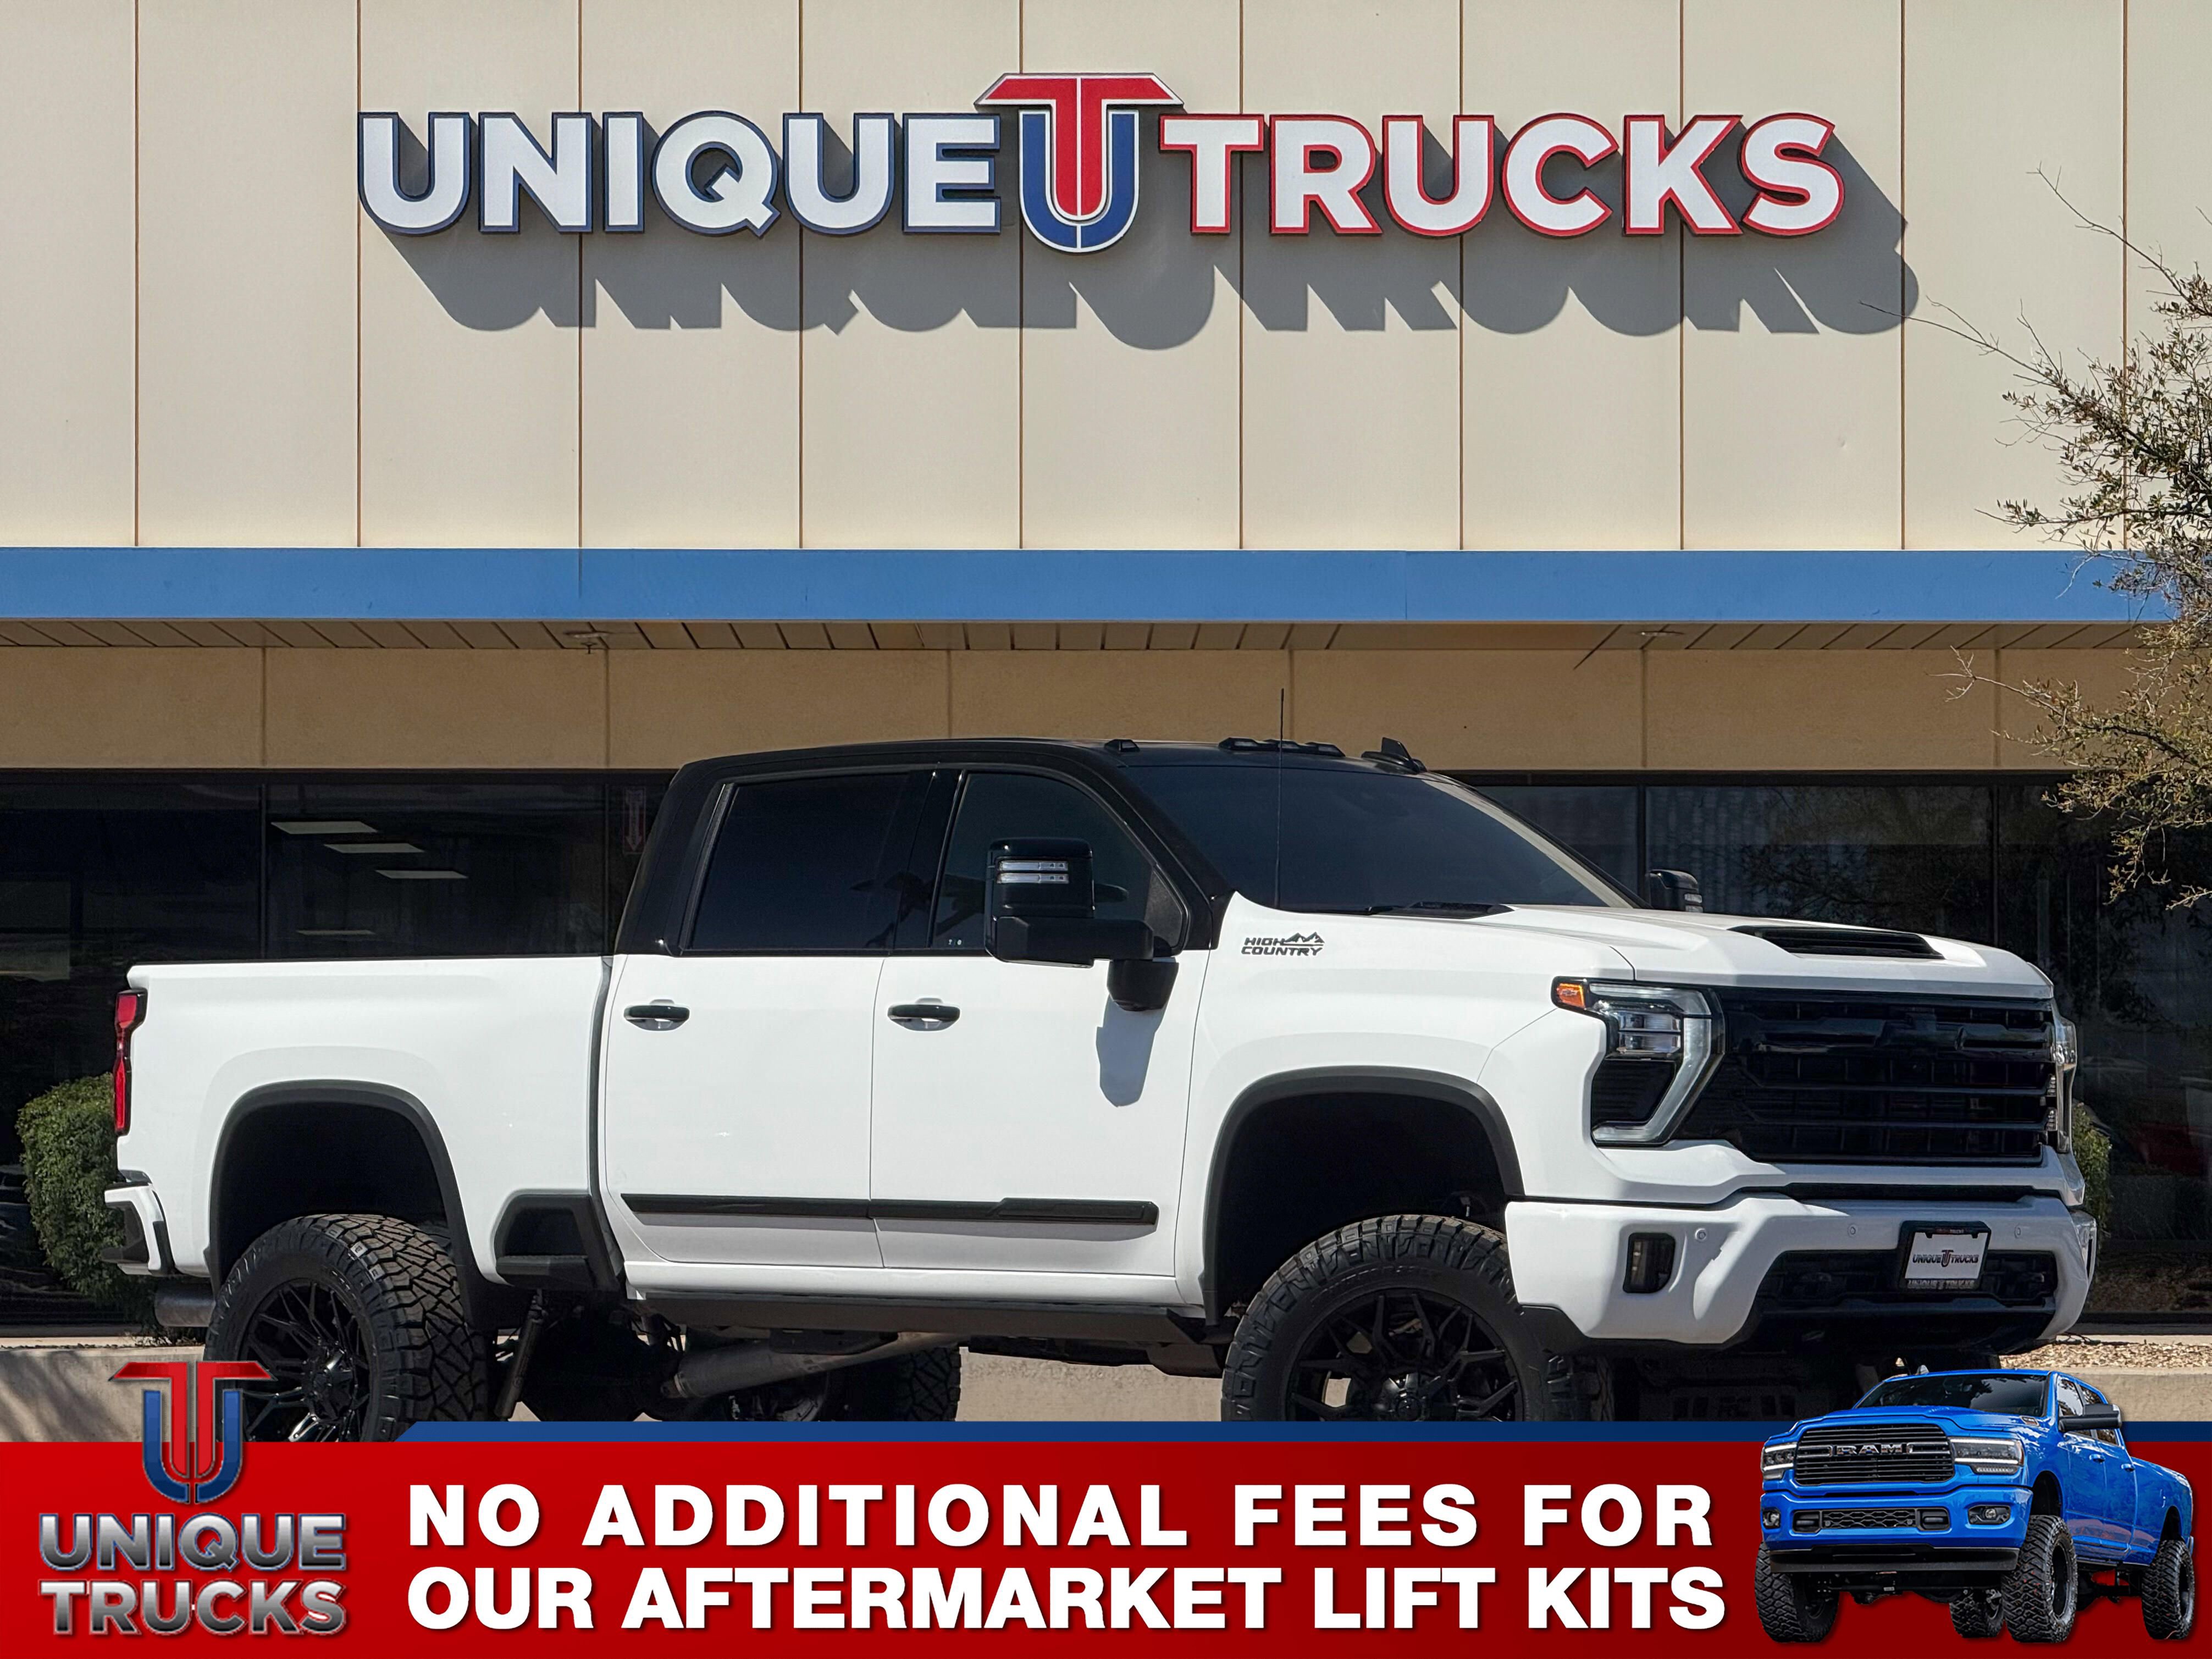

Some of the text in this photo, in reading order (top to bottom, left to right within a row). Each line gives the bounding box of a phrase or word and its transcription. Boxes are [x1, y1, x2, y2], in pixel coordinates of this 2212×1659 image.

[357, 110, 1002, 237] UNIQUE
[1159, 113, 1845, 237] TRUCKS
[1244, 937, 1285, 945] HIGH
[1241, 947, 1323, 956] COUNTRY
[1912, 1254, 1942, 1263] UNIQUE
[1950, 1254, 1979, 1263] TRUCKS
